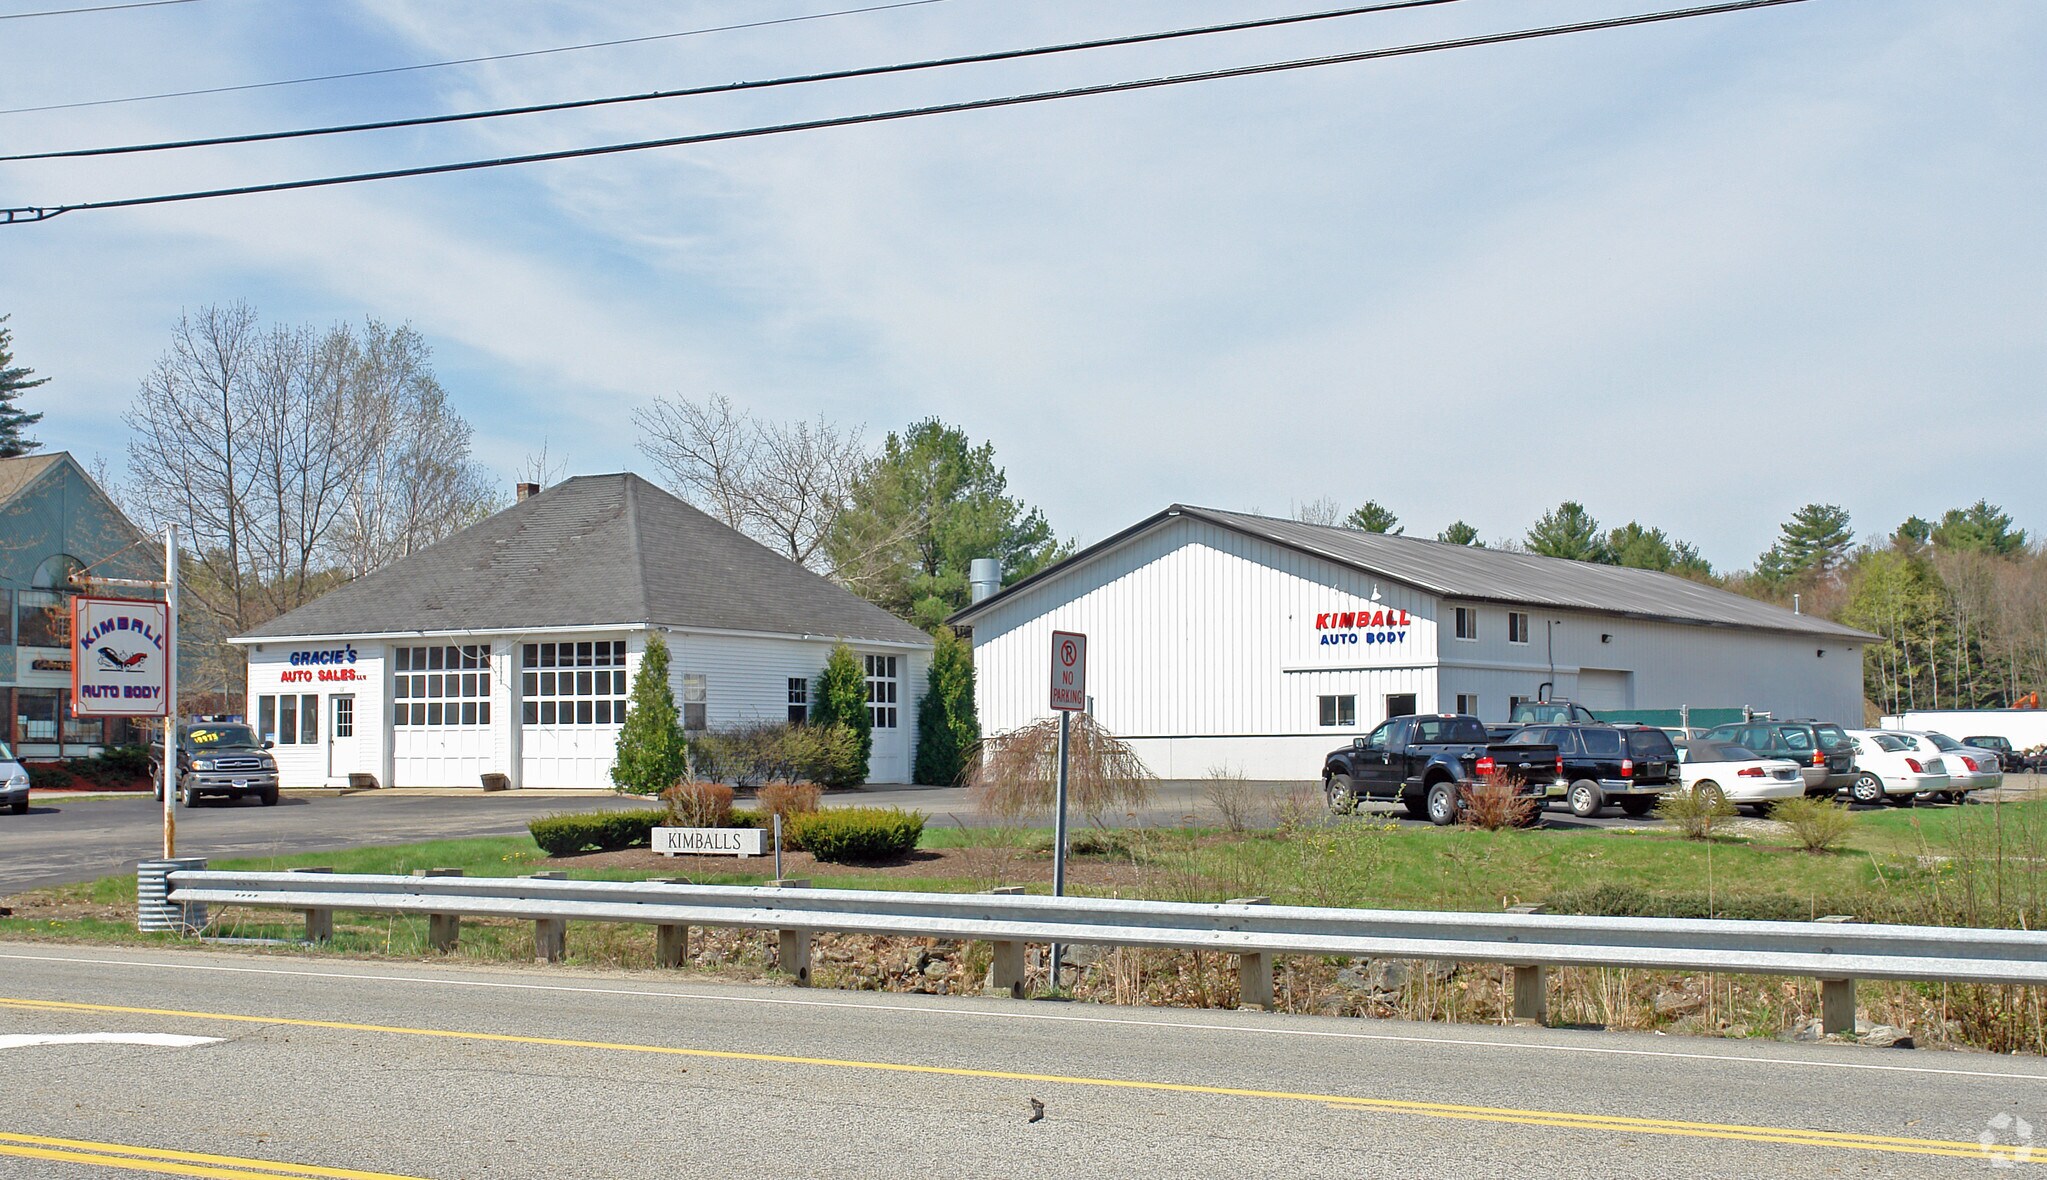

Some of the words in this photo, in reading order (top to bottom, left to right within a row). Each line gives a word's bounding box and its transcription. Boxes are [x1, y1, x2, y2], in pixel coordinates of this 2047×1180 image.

[1315, 609, 1411, 630] KIMBALL
[80, 616, 163, 651] KIMBALL
[1320, 633, 1358, 645] AUTO
[1366, 631, 1406, 645] BODY
[289, 643, 358, 666] GRACIE'S
[280, 670, 313, 683] AUTO
[317, 668, 356, 682] SALES
[1062, 671, 1074, 686] NO
[82, 685, 119, 698] AUTO
[123, 686, 161, 699] BODY
[1053, 688, 1082, 704] PARKING
[668, 832, 741, 850] KIMBALLS
